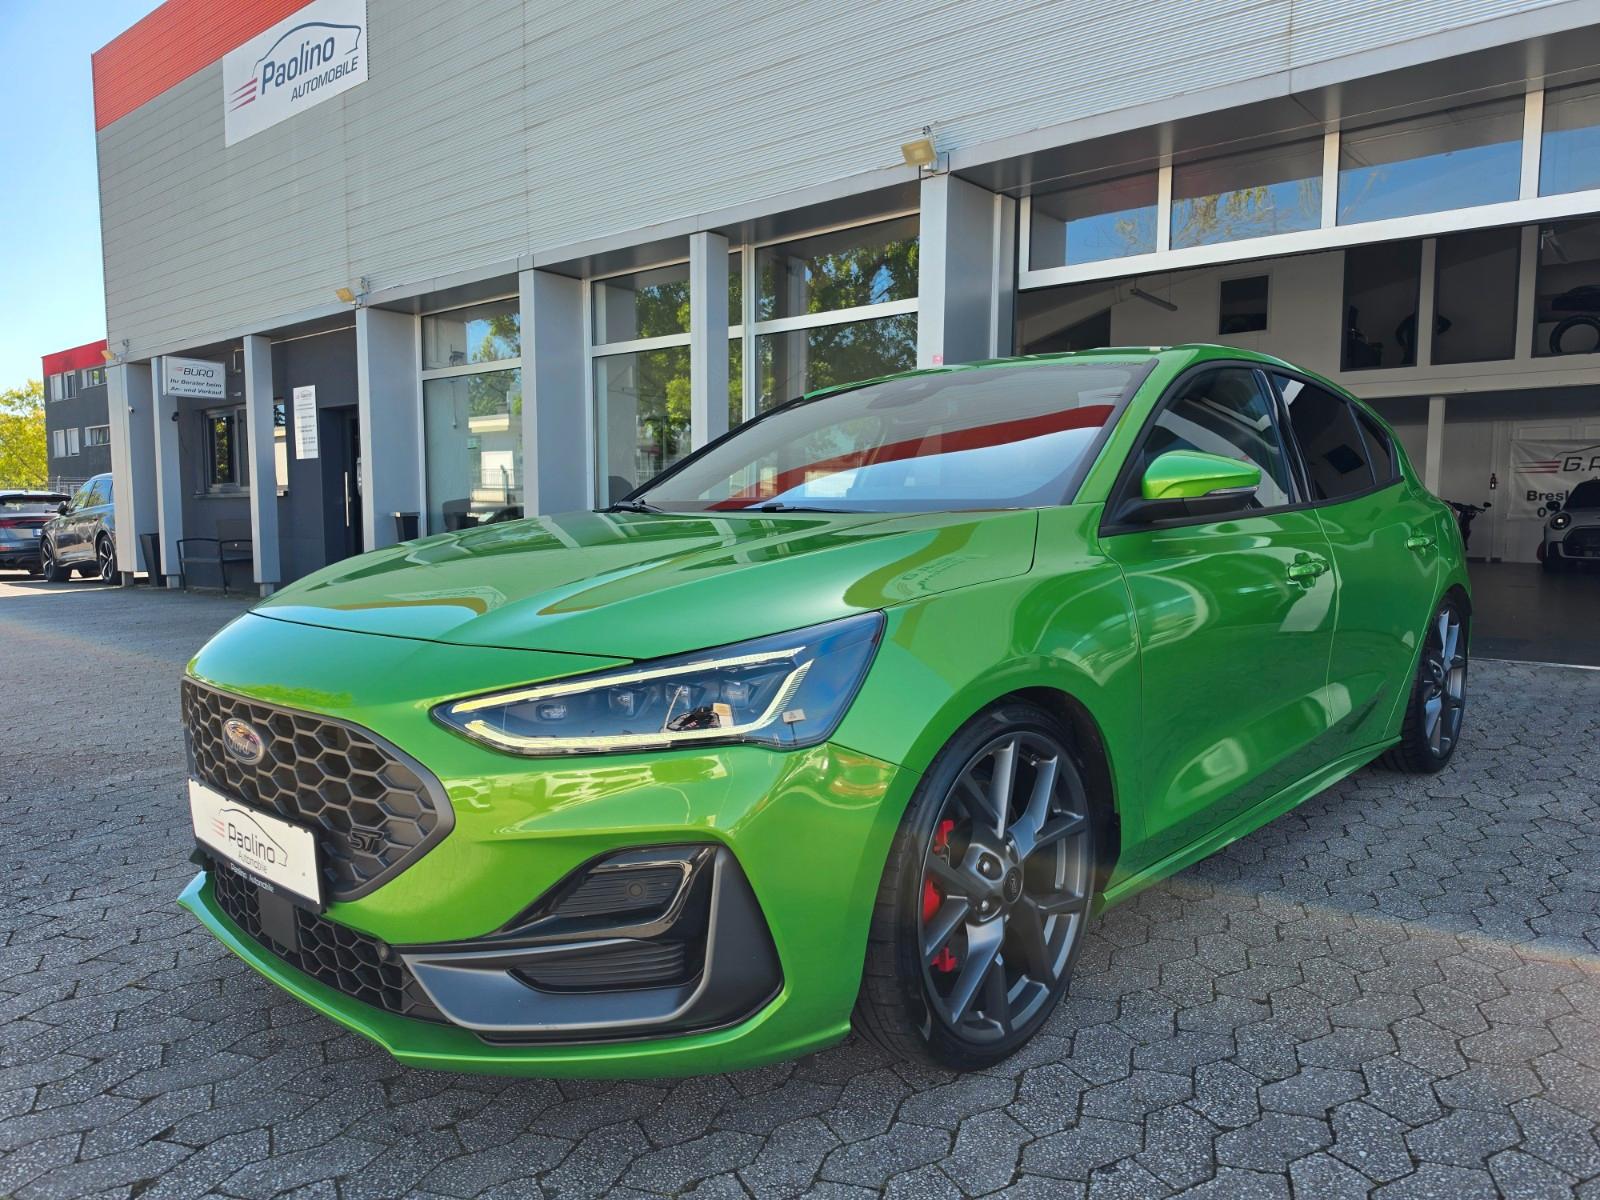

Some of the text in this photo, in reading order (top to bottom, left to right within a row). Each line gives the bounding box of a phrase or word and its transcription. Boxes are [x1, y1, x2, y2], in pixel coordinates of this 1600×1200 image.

[261, 36, 335, 96] Paolino
[290, 56, 359, 102] AUTOMOBILE
[228, 822, 276, 864] Paolino
[346, 828, 384, 854] ST
